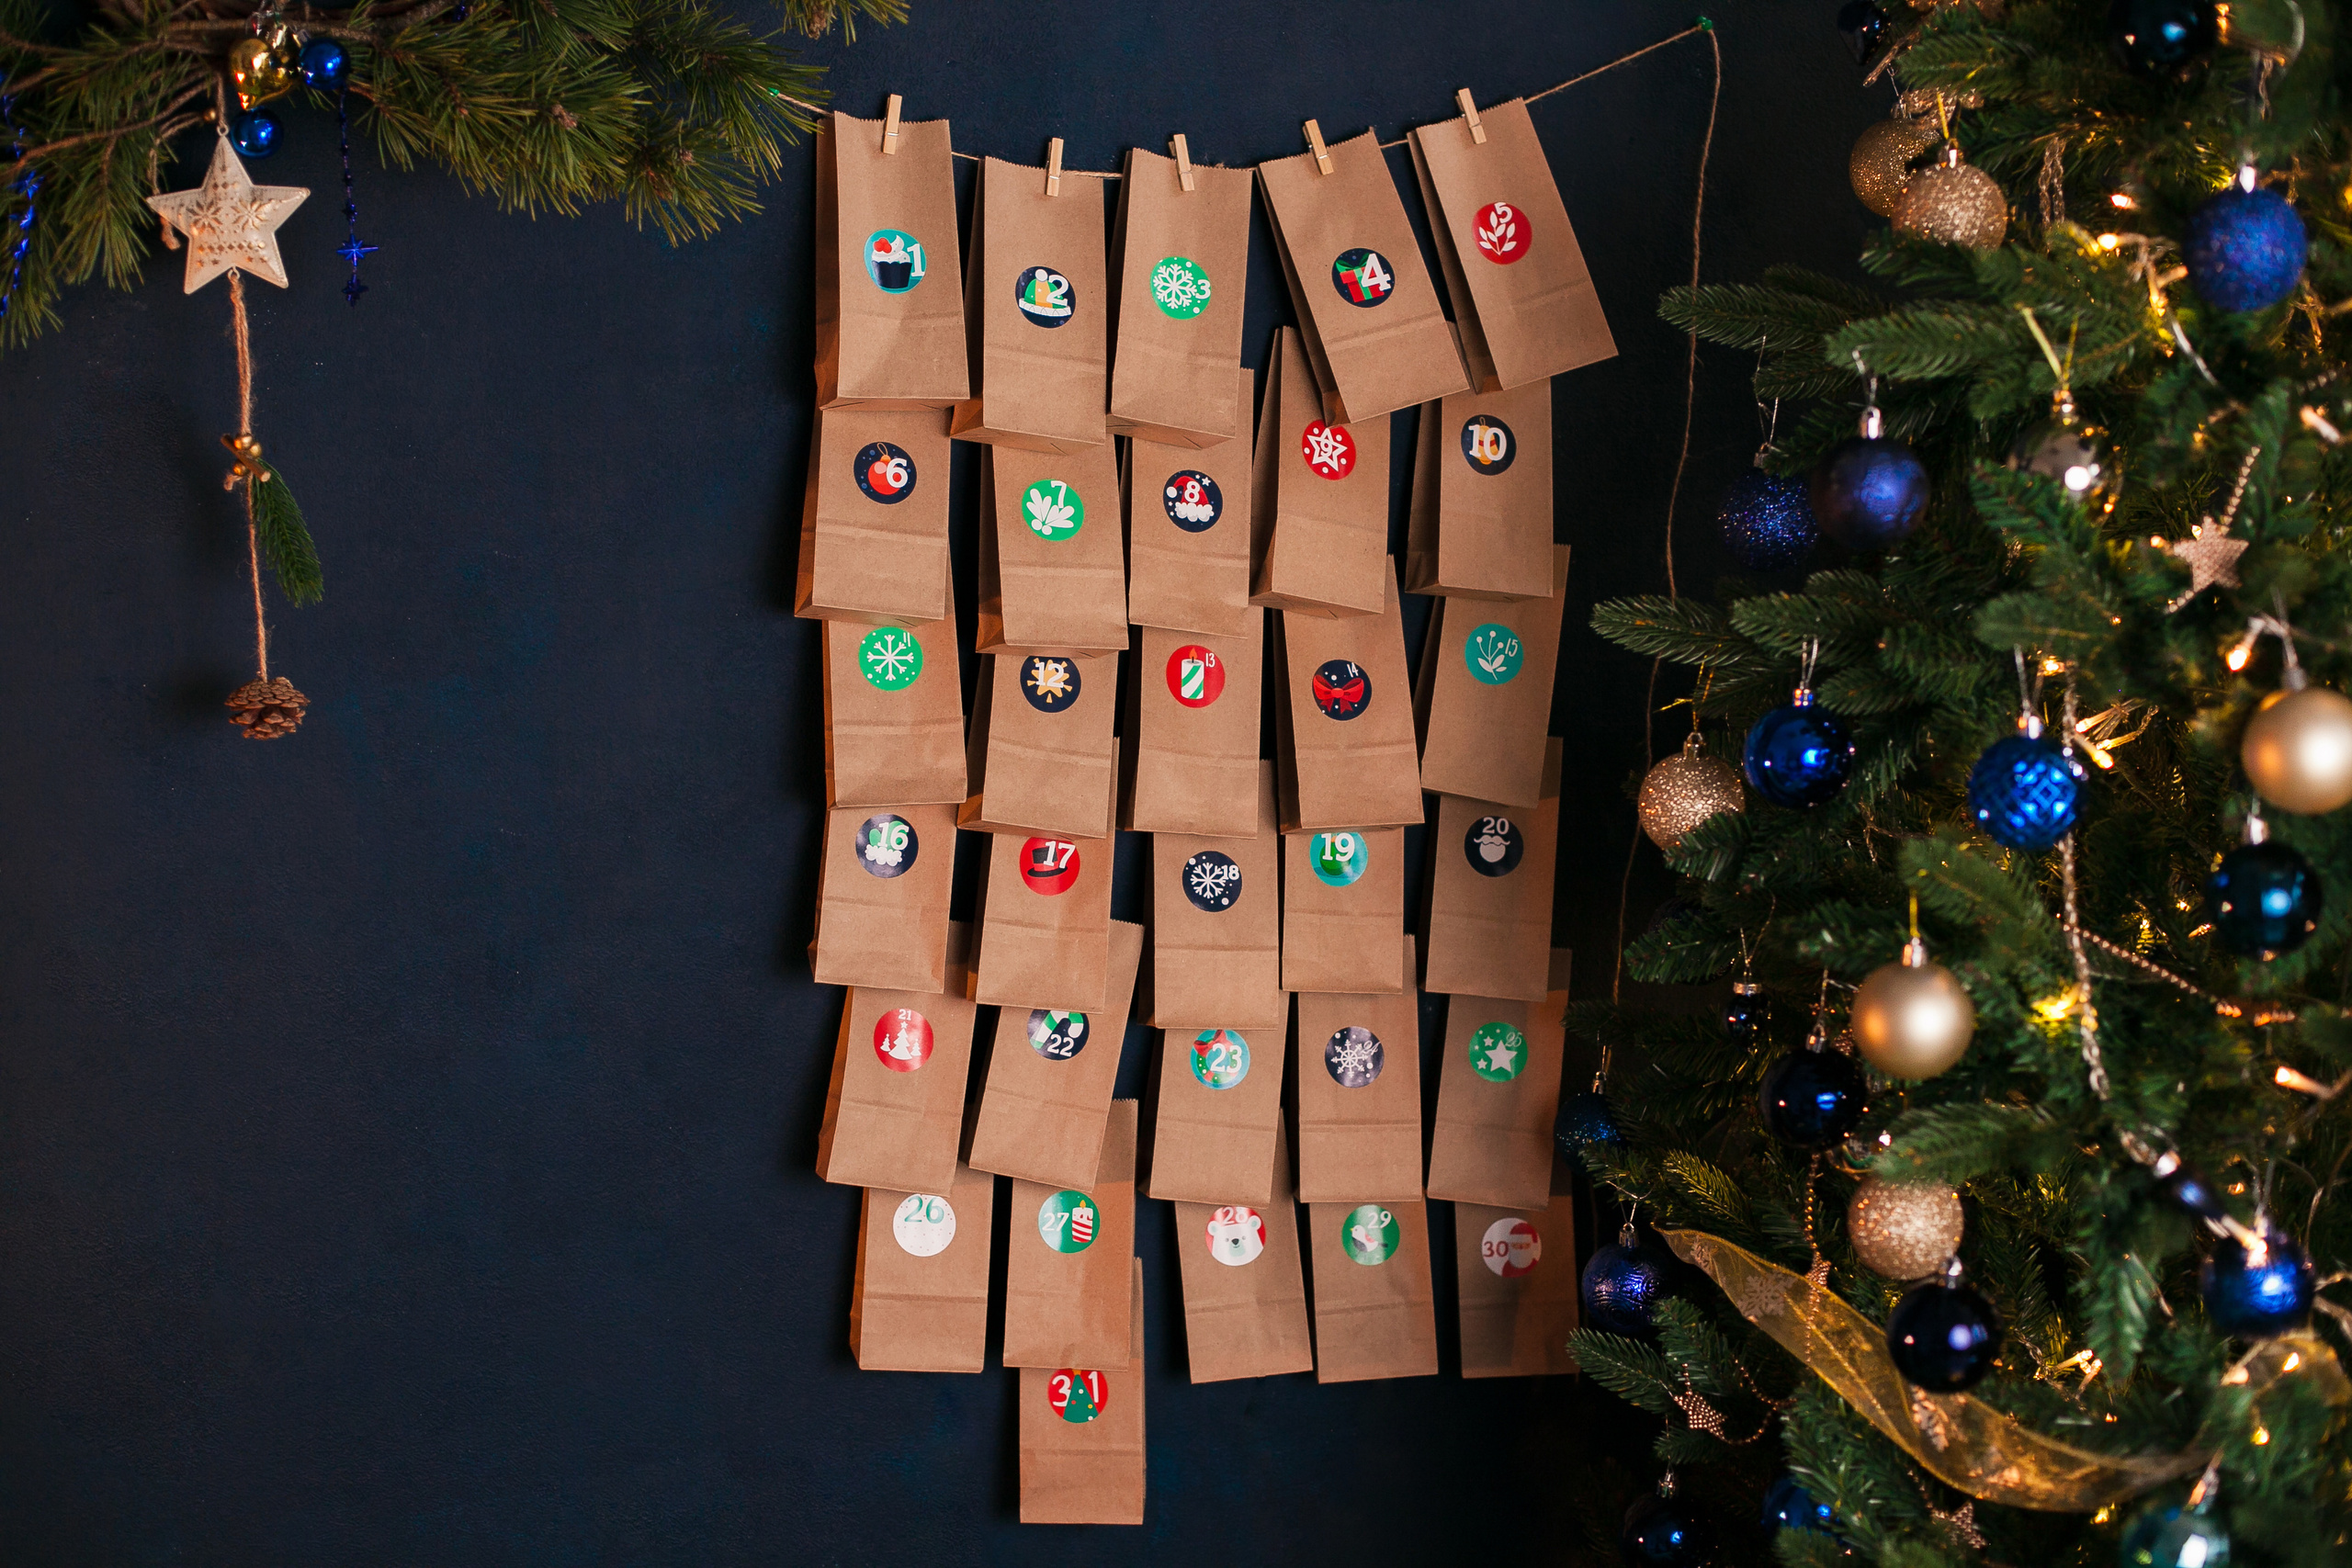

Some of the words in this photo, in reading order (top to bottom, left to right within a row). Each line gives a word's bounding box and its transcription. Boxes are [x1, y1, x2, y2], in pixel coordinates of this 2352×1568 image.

[1494, 202, 1512, 223] 5
[908, 243, 925, 277] 1
[1362, 253, 1391, 292] 4
[1046, 275, 1069, 305] 2
[1195, 279, 1211, 299] 3
[1320, 440, 1332, 457] 9
[1468, 424, 1507, 461] 10
[886, 458, 908, 488] 6
[1050, 480, 1067, 509] 7
[1184, 481, 1200, 502] 8
[1505, 637, 1519, 657] 15
[1205, 652, 1216, 667] 13
[1346, 661, 1359, 678] 14
[1035, 661, 1065, 689] 12
[877, 822, 910, 851] 16
[1483, 817, 1510, 835] 20
[1043, 841, 1076, 869] 17
[1321, 832, 1355, 862] 19
[1220, 864, 1240, 880] 18
[898, 1009, 912, 1021] 21
[1047, 1033, 1075, 1057] 22
[1362, 1040, 1382, 1056] 24
[1505, 1031, 1522, 1047] 25
[1210, 1043, 1242, 1073] 23
[904, 1196, 944, 1224] 26
[1223, 1207, 1248, 1224] 28
[1367, 1211, 1392, 1229] 29
[1042, 1213, 1069, 1232] 27
[1483, 1242, 1509, 1258] 30
